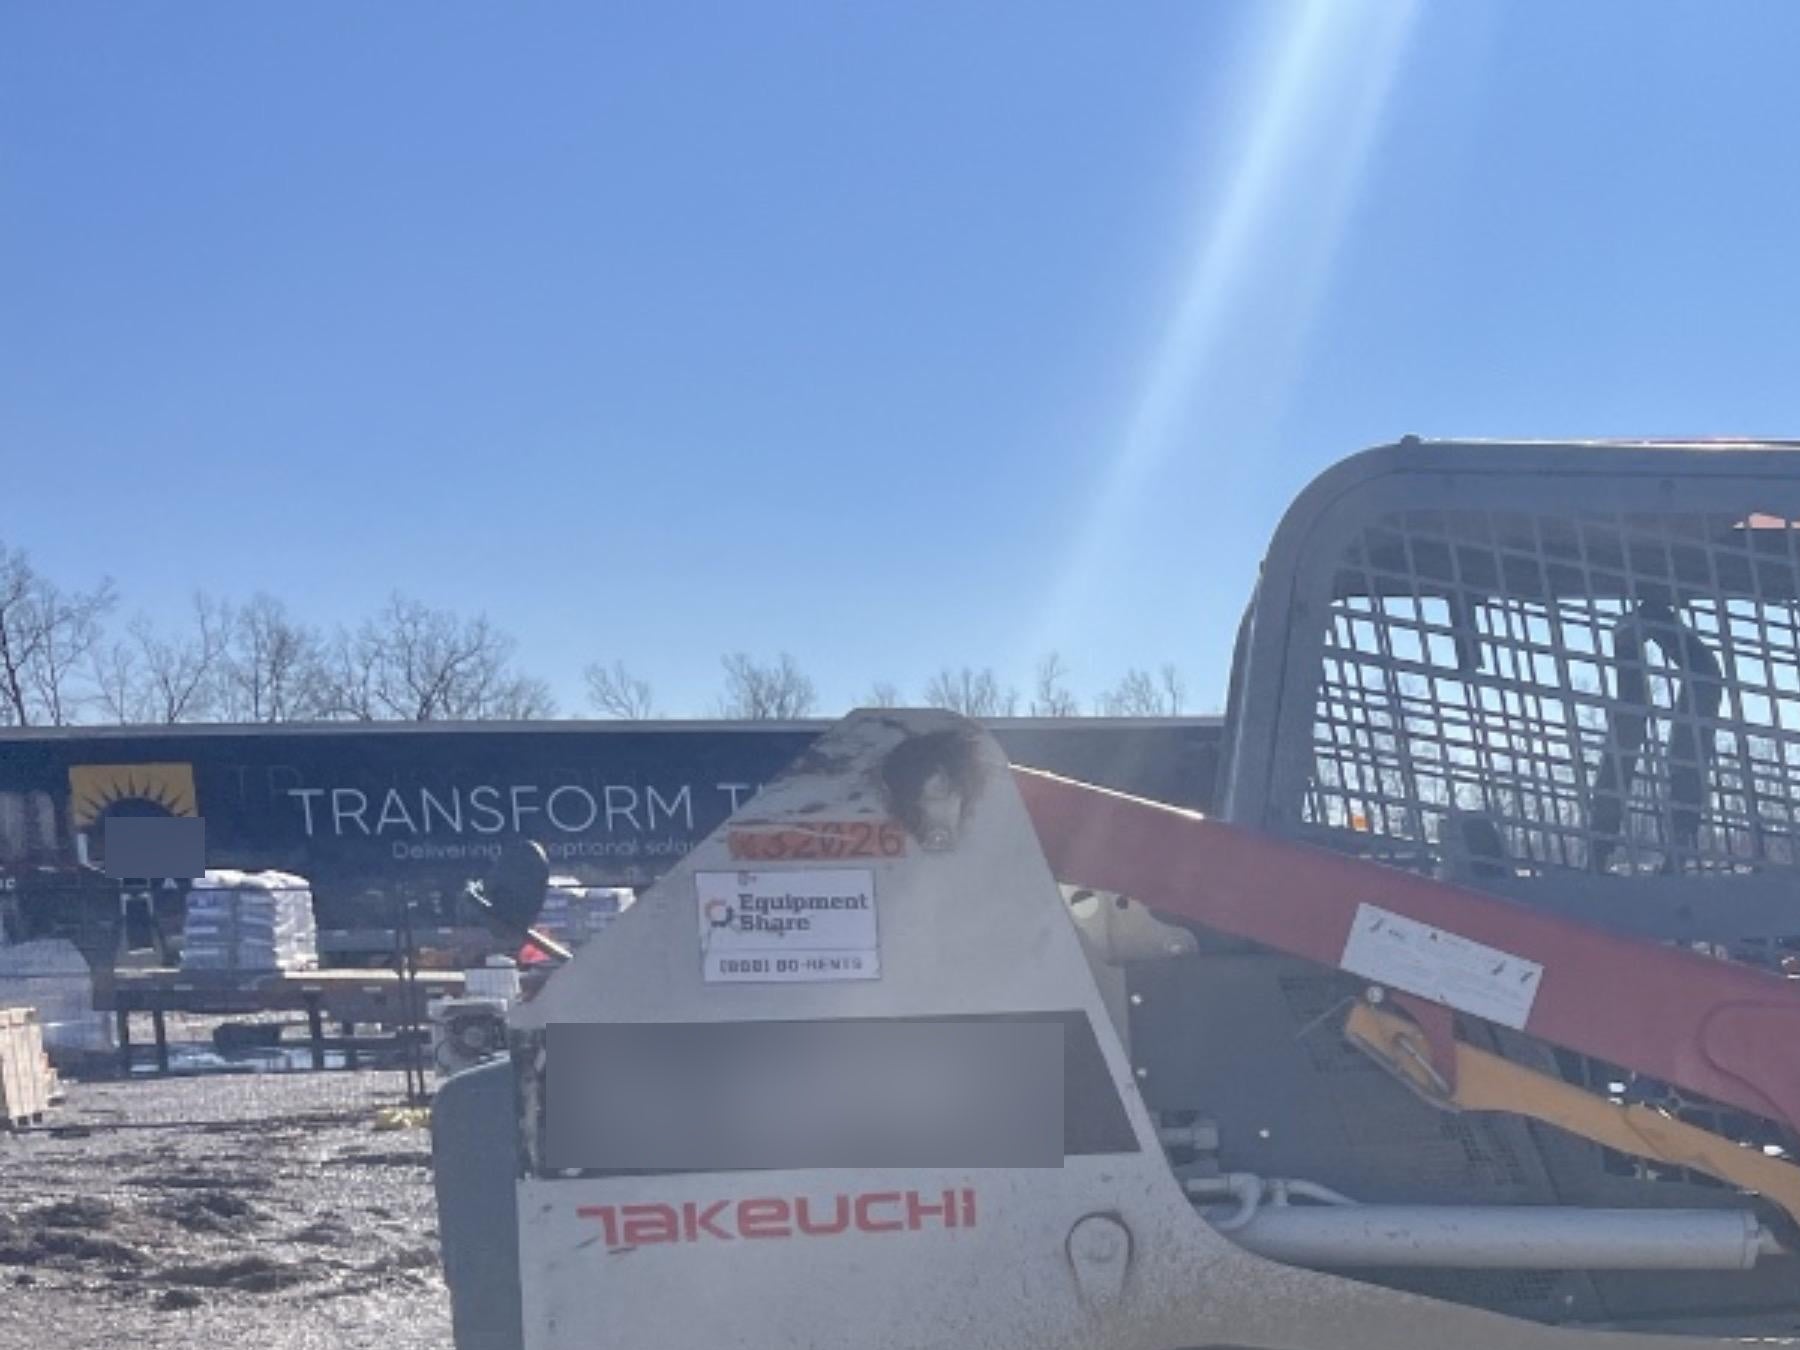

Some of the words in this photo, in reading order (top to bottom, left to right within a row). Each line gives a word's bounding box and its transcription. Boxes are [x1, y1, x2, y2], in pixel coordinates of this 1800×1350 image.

[287, 784, 695, 837] TRANSFORM
[392, 839, 502, 861] Delivering
[737, 893, 869, 914] Equipment
[739, 914, 811, 932] Share
